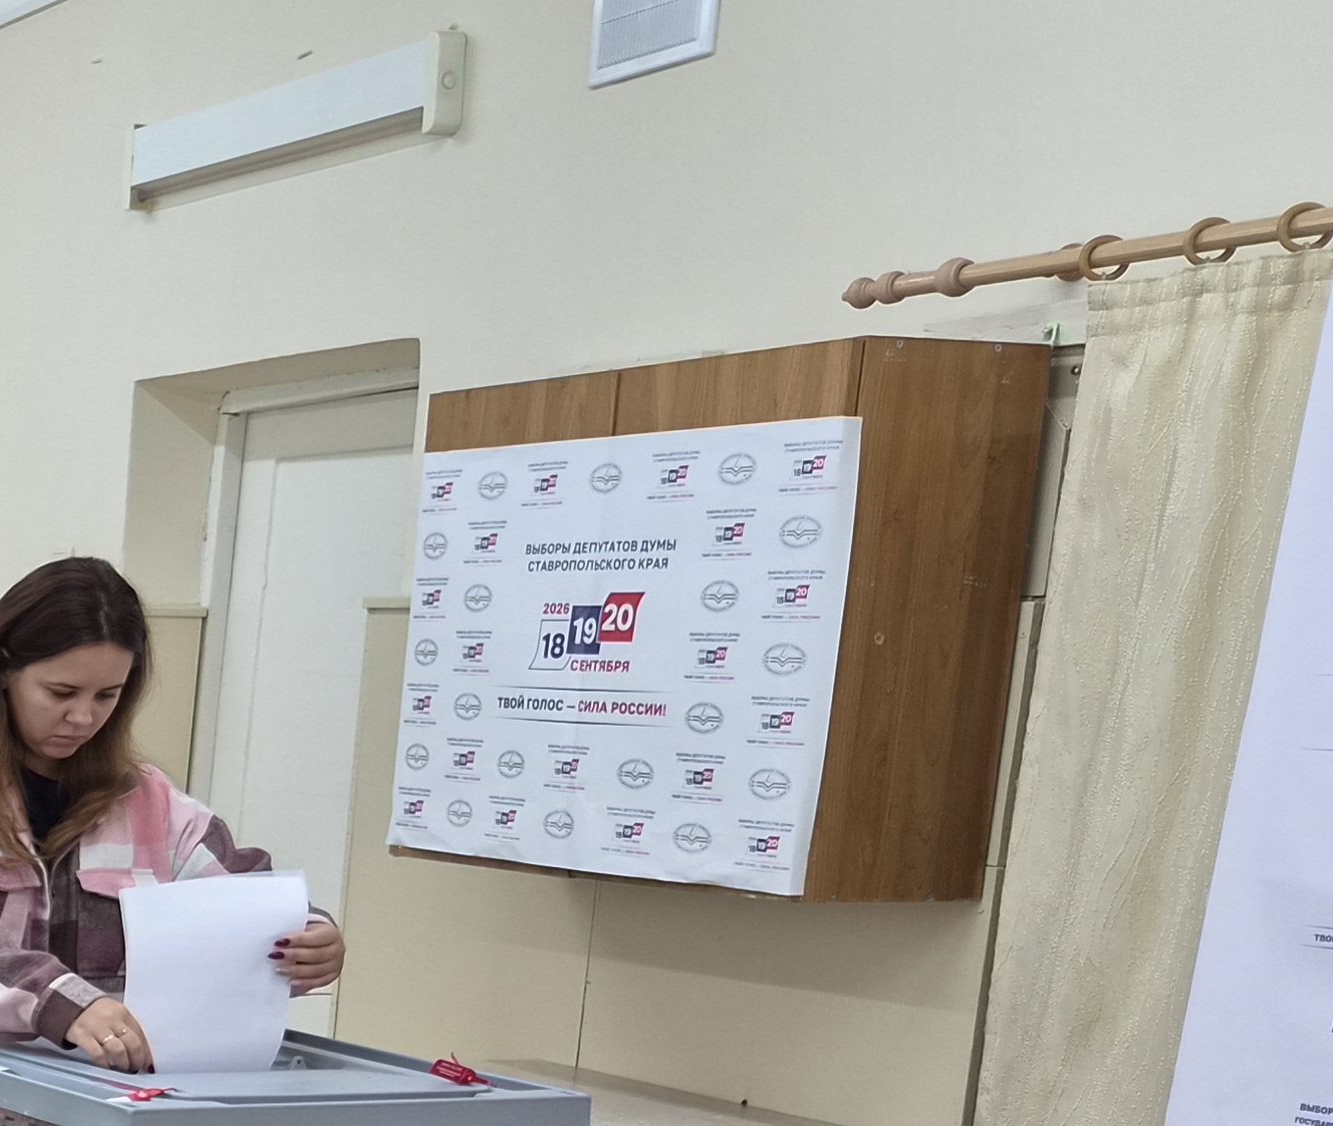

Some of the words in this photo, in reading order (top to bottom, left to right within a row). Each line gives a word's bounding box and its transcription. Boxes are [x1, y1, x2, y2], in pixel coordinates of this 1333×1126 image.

[525, 540, 571, 556] ВЫБОРЫ
[573, 540, 638, 556] ДЕПУТАТОВ
[639, 538, 677, 555] ДУМЫ
[527, 558, 636, 573] СТАВРОПОЛЬСКОГО
[637, 557, 669, 571] КРАЯ
[542, 602, 570, 616] 2026
[541, 633, 566, 660] 18
[572, 617, 598, 646] 19
[601, 603, 633, 632] 20
[569, 659, 631, 674] СЕНТЯБРЯ
[497, 695, 526, 711] ТВОЙ
[527, 698, 564, 712] ГОЛОС
[577, 701, 607, 716] СИЛА
[609, 702, 667, 717] РОССИИ!
[1314, 934, 1333, 943] ТВО
